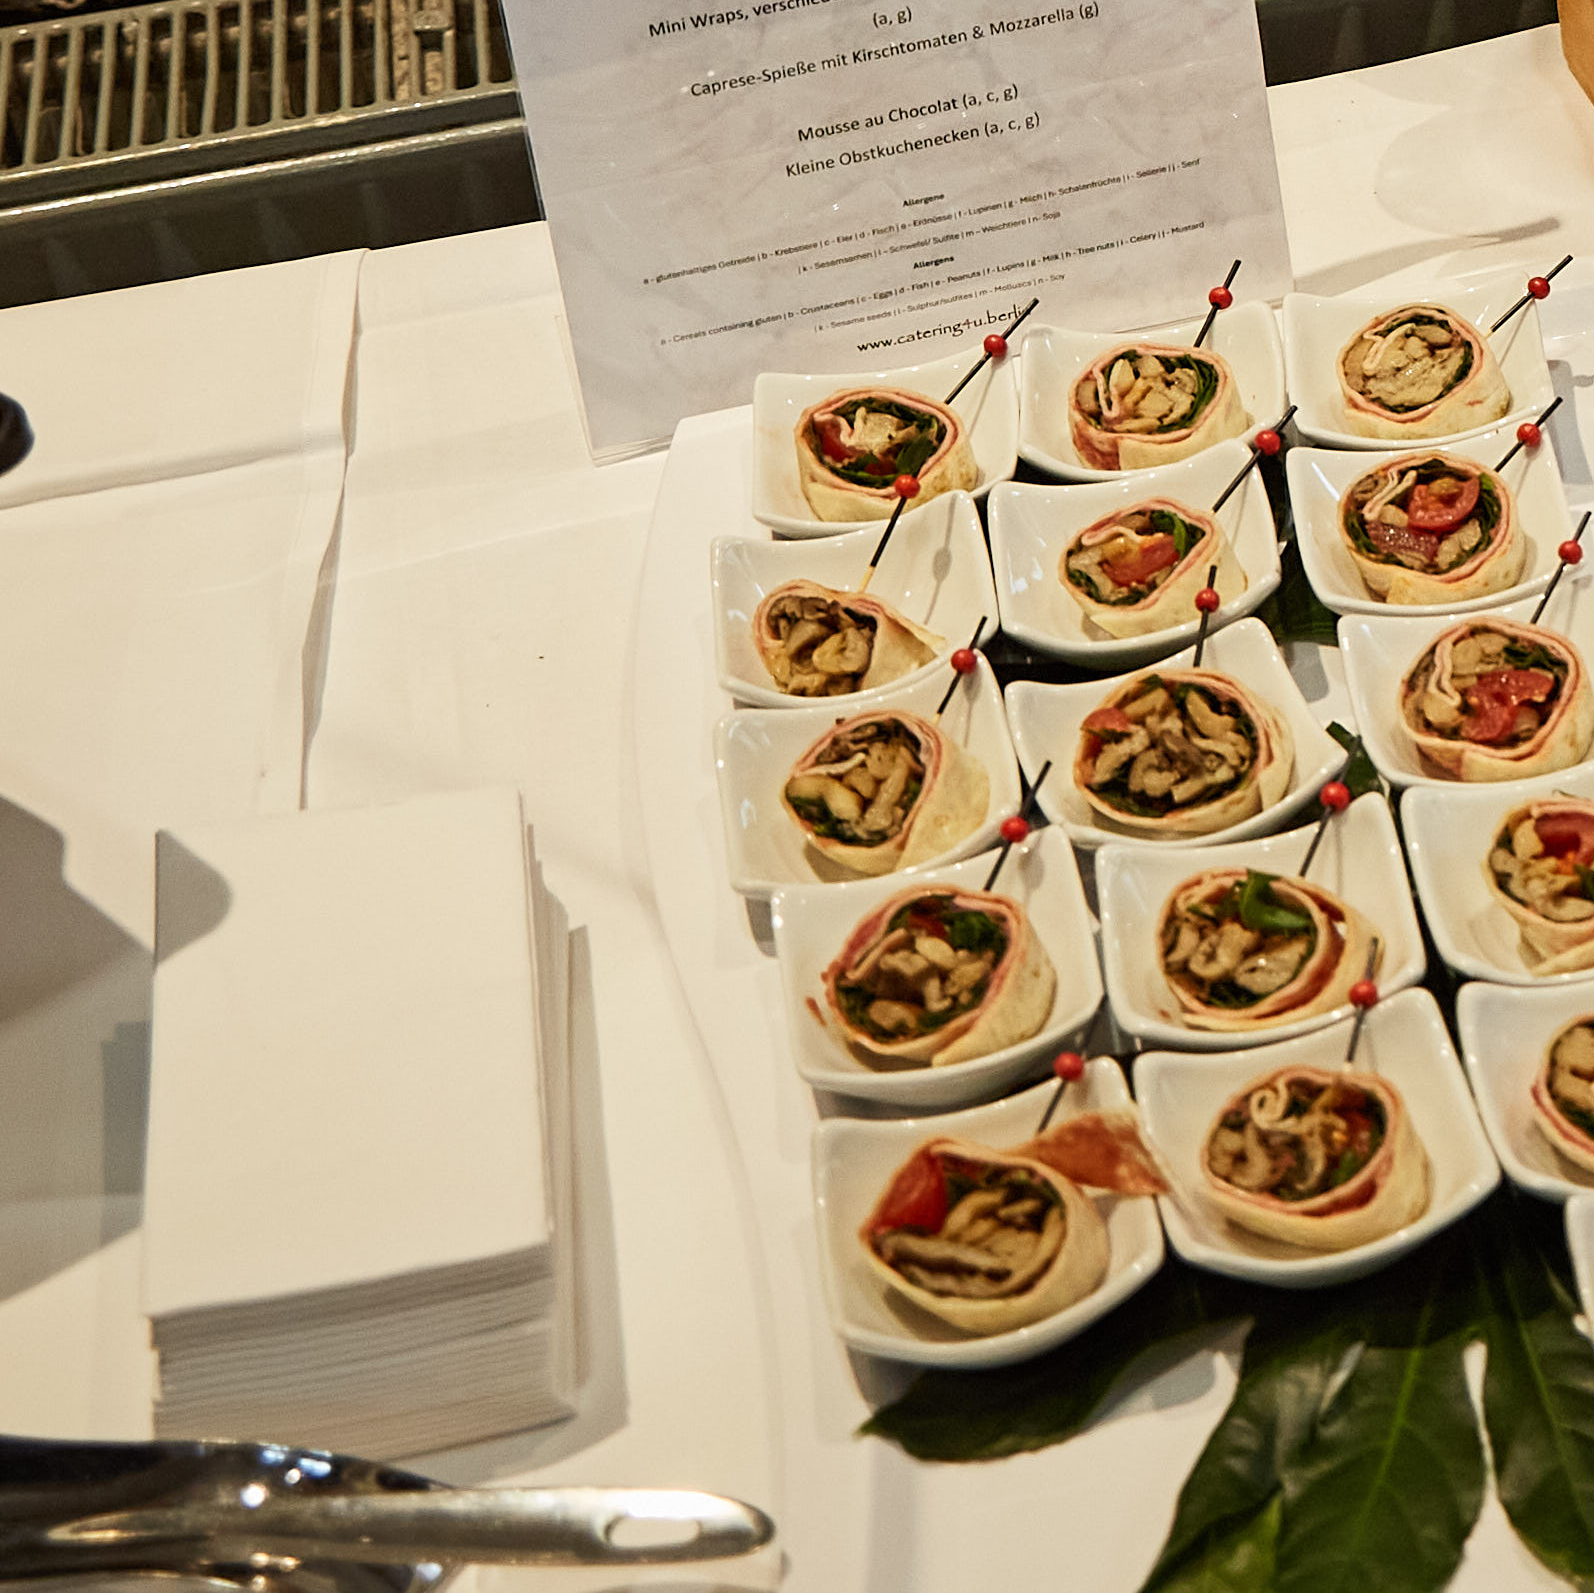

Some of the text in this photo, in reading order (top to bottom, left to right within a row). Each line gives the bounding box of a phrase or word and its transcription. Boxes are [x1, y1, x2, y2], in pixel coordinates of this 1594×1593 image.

[647, 16, 687, 38] Mini
[688, 8, 749, 29] Wraps,
[871, 11, 893, 29] (a,
[689, 0, 1099, 97] Caprese-Spieße mit Kirschtomaten & Mozzarella (g)
[796, 119, 860, 142] Mousse
[887, 97, 959, 123] Chocolat
[961, 92, 982, 110] (a,
[784, 157, 835, 178] Kleine
[838, 126, 980, 166] Obstkuchenecken
[983, 120, 1004, 138] (a,
[901, 192, 945, 207] Allergene
[912, 255, 955, 270] Allergens
[856, 303, 1029, 352] www.catering4u.berli
